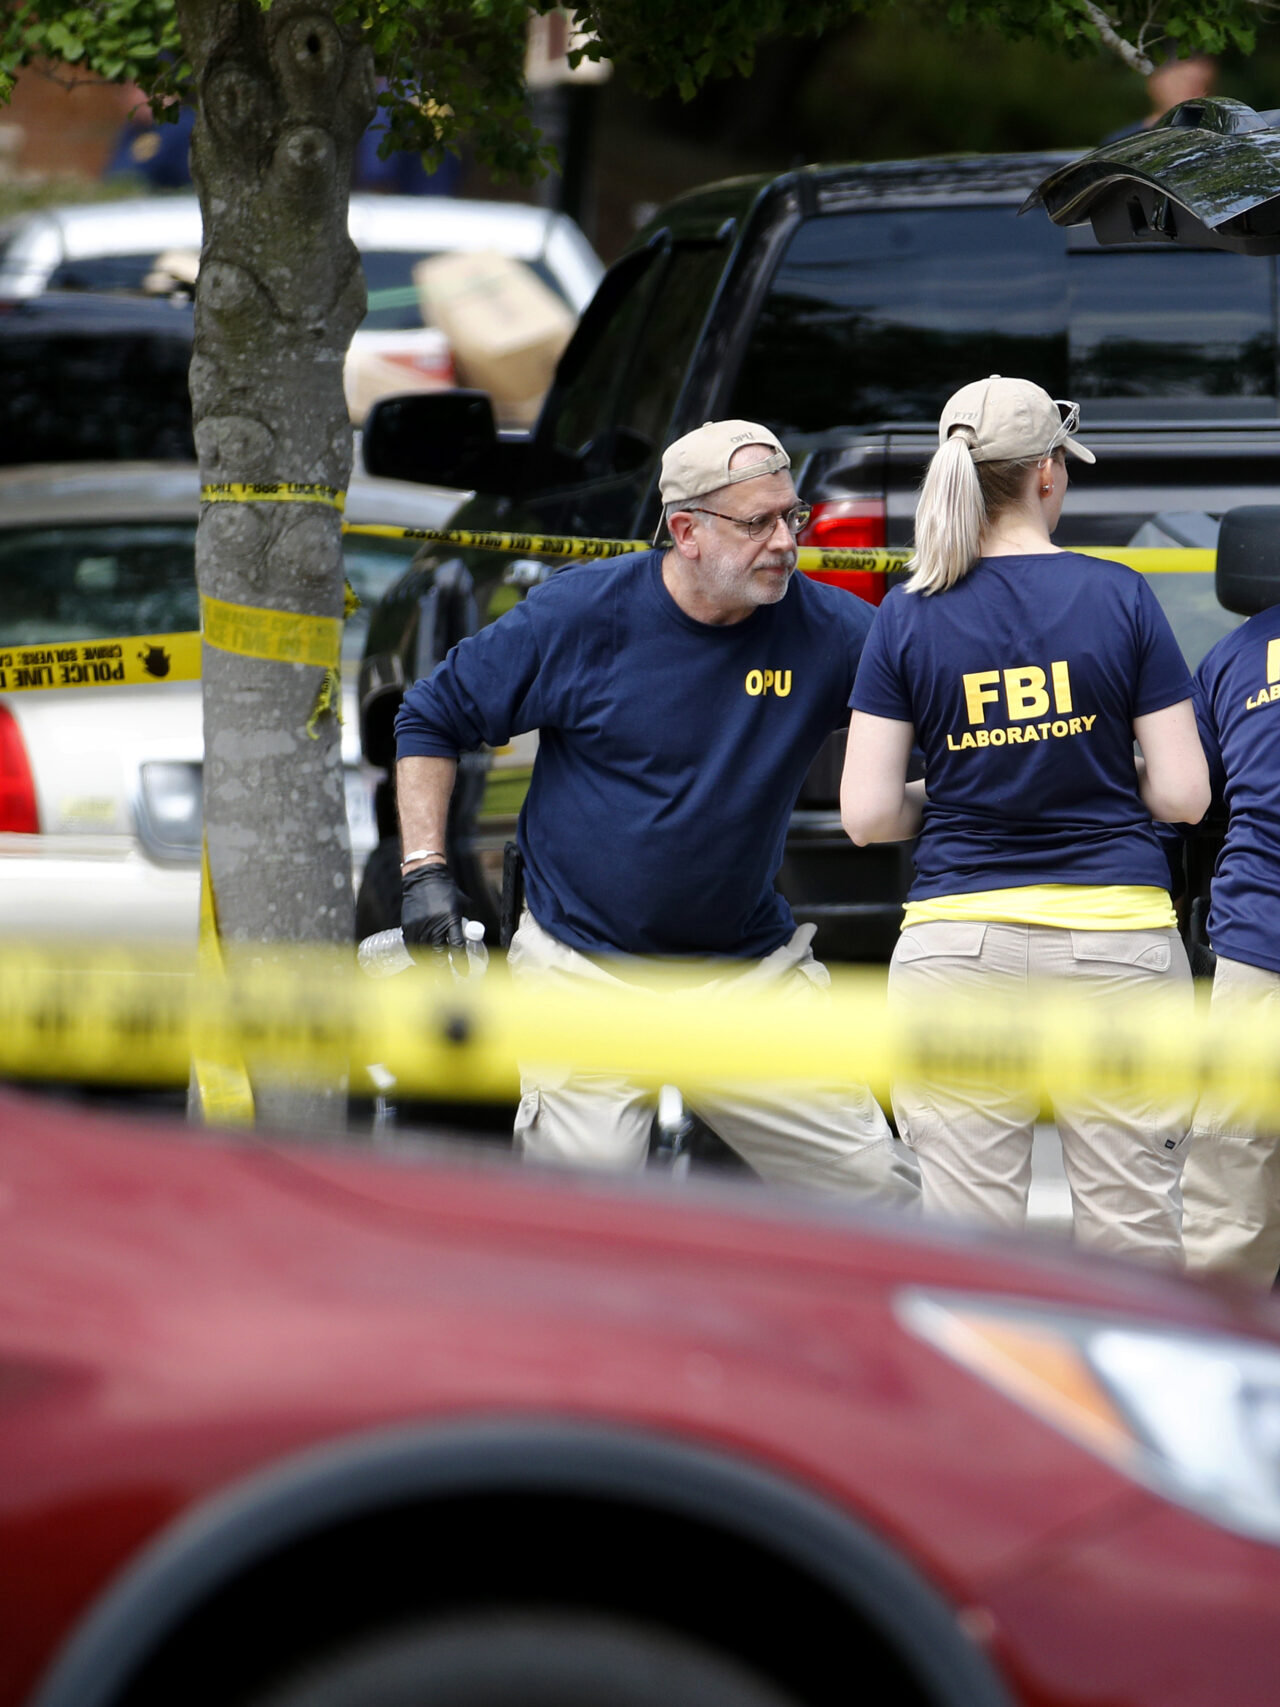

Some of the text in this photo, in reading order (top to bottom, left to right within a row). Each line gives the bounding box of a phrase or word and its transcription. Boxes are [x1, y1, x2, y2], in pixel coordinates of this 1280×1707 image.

[730, 431, 755, 444] OPU
[82, 645, 123, 661] CRIME
[13, 666, 54, 688] LINE
[61, 661, 125, 684] POLICE
[745, 669, 792, 697] OPU
[962, 660, 1073, 725] FBI
[946, 714, 1097, 751] LABORATORY
